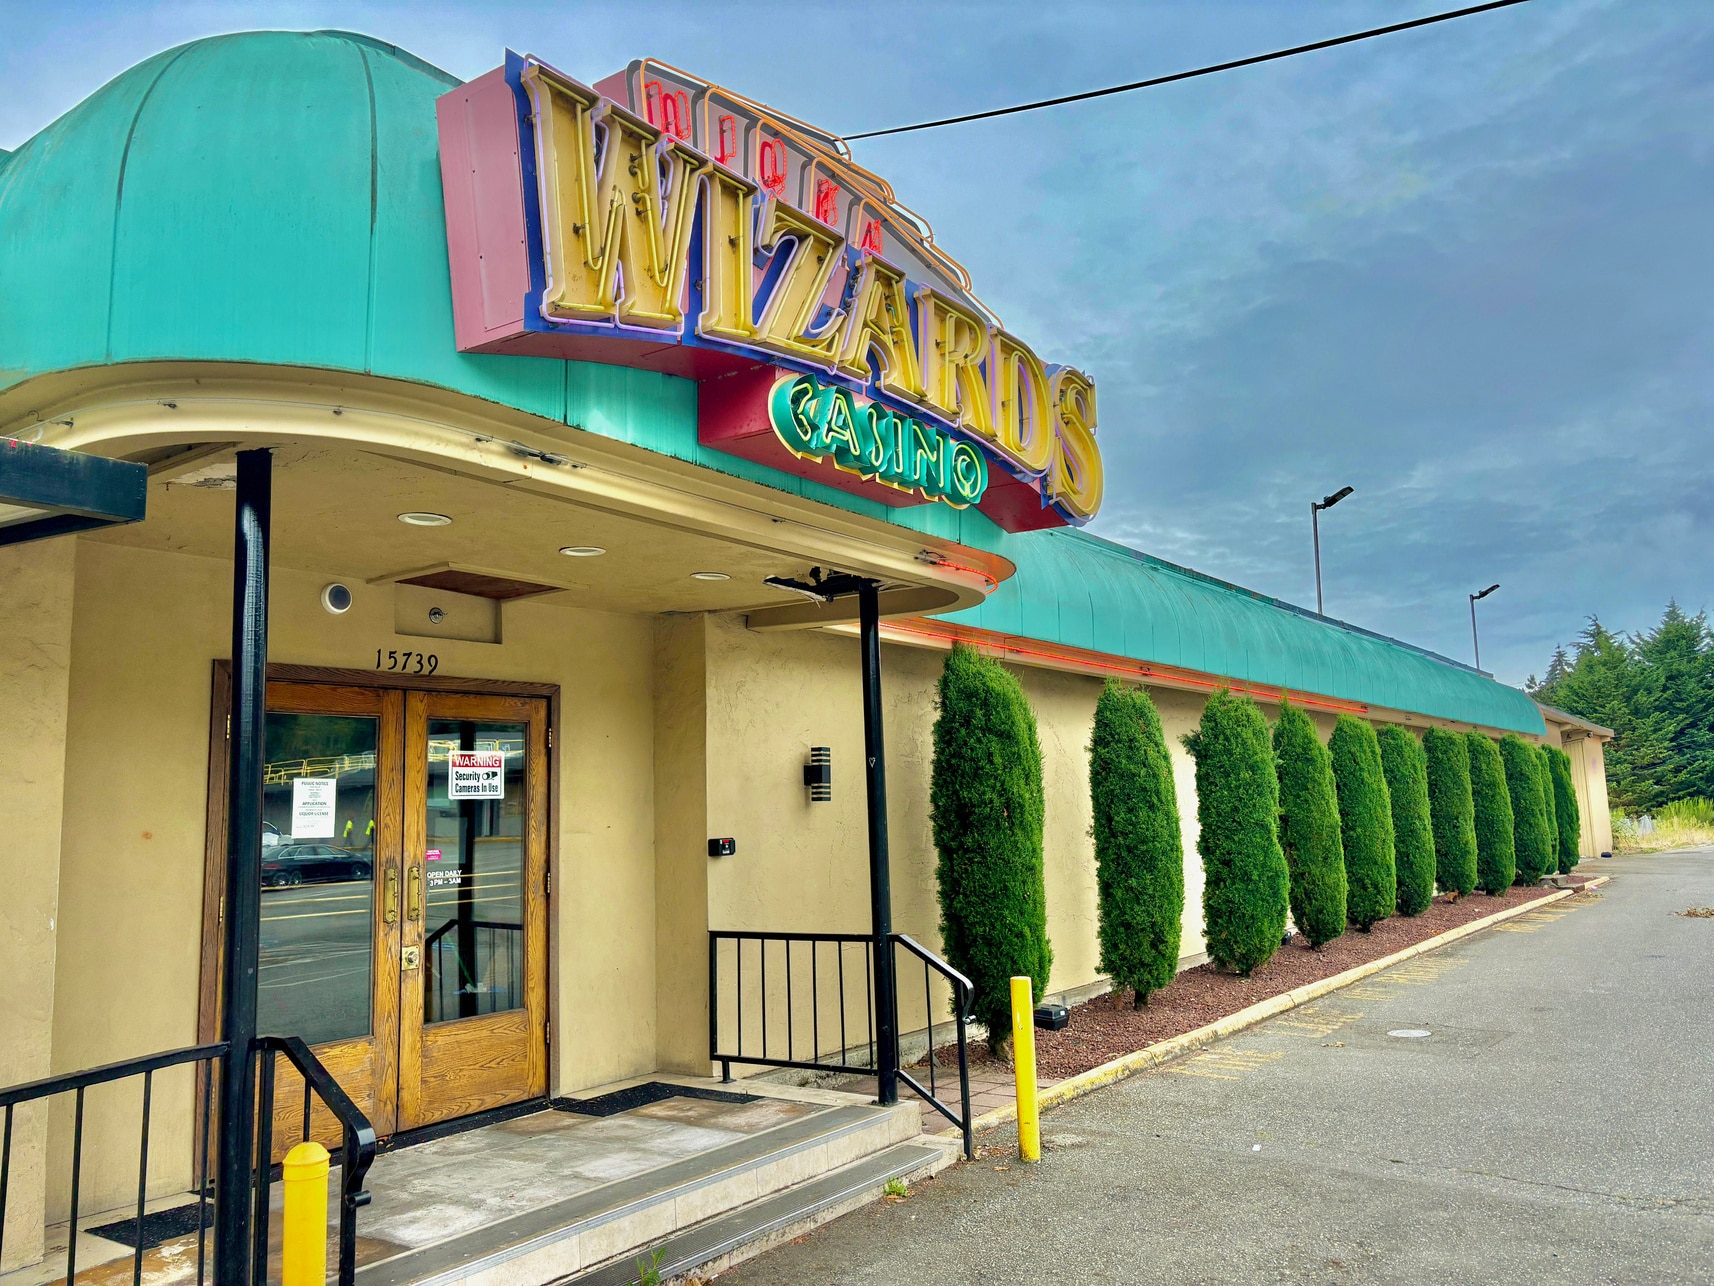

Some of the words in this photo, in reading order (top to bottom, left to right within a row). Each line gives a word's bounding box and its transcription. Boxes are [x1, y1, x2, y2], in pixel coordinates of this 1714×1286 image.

[521, 53, 1104, 525] WIZARDS
[768, 372, 989, 510] CASINO
[376, 648, 438, 676] 15739
[455, 755, 500, 767] WARNING
[455, 771, 480, 782] Security
[455, 783, 480, 793] Cameras
[482, 783, 487, 792] In
[488, 783, 498, 792] Use
